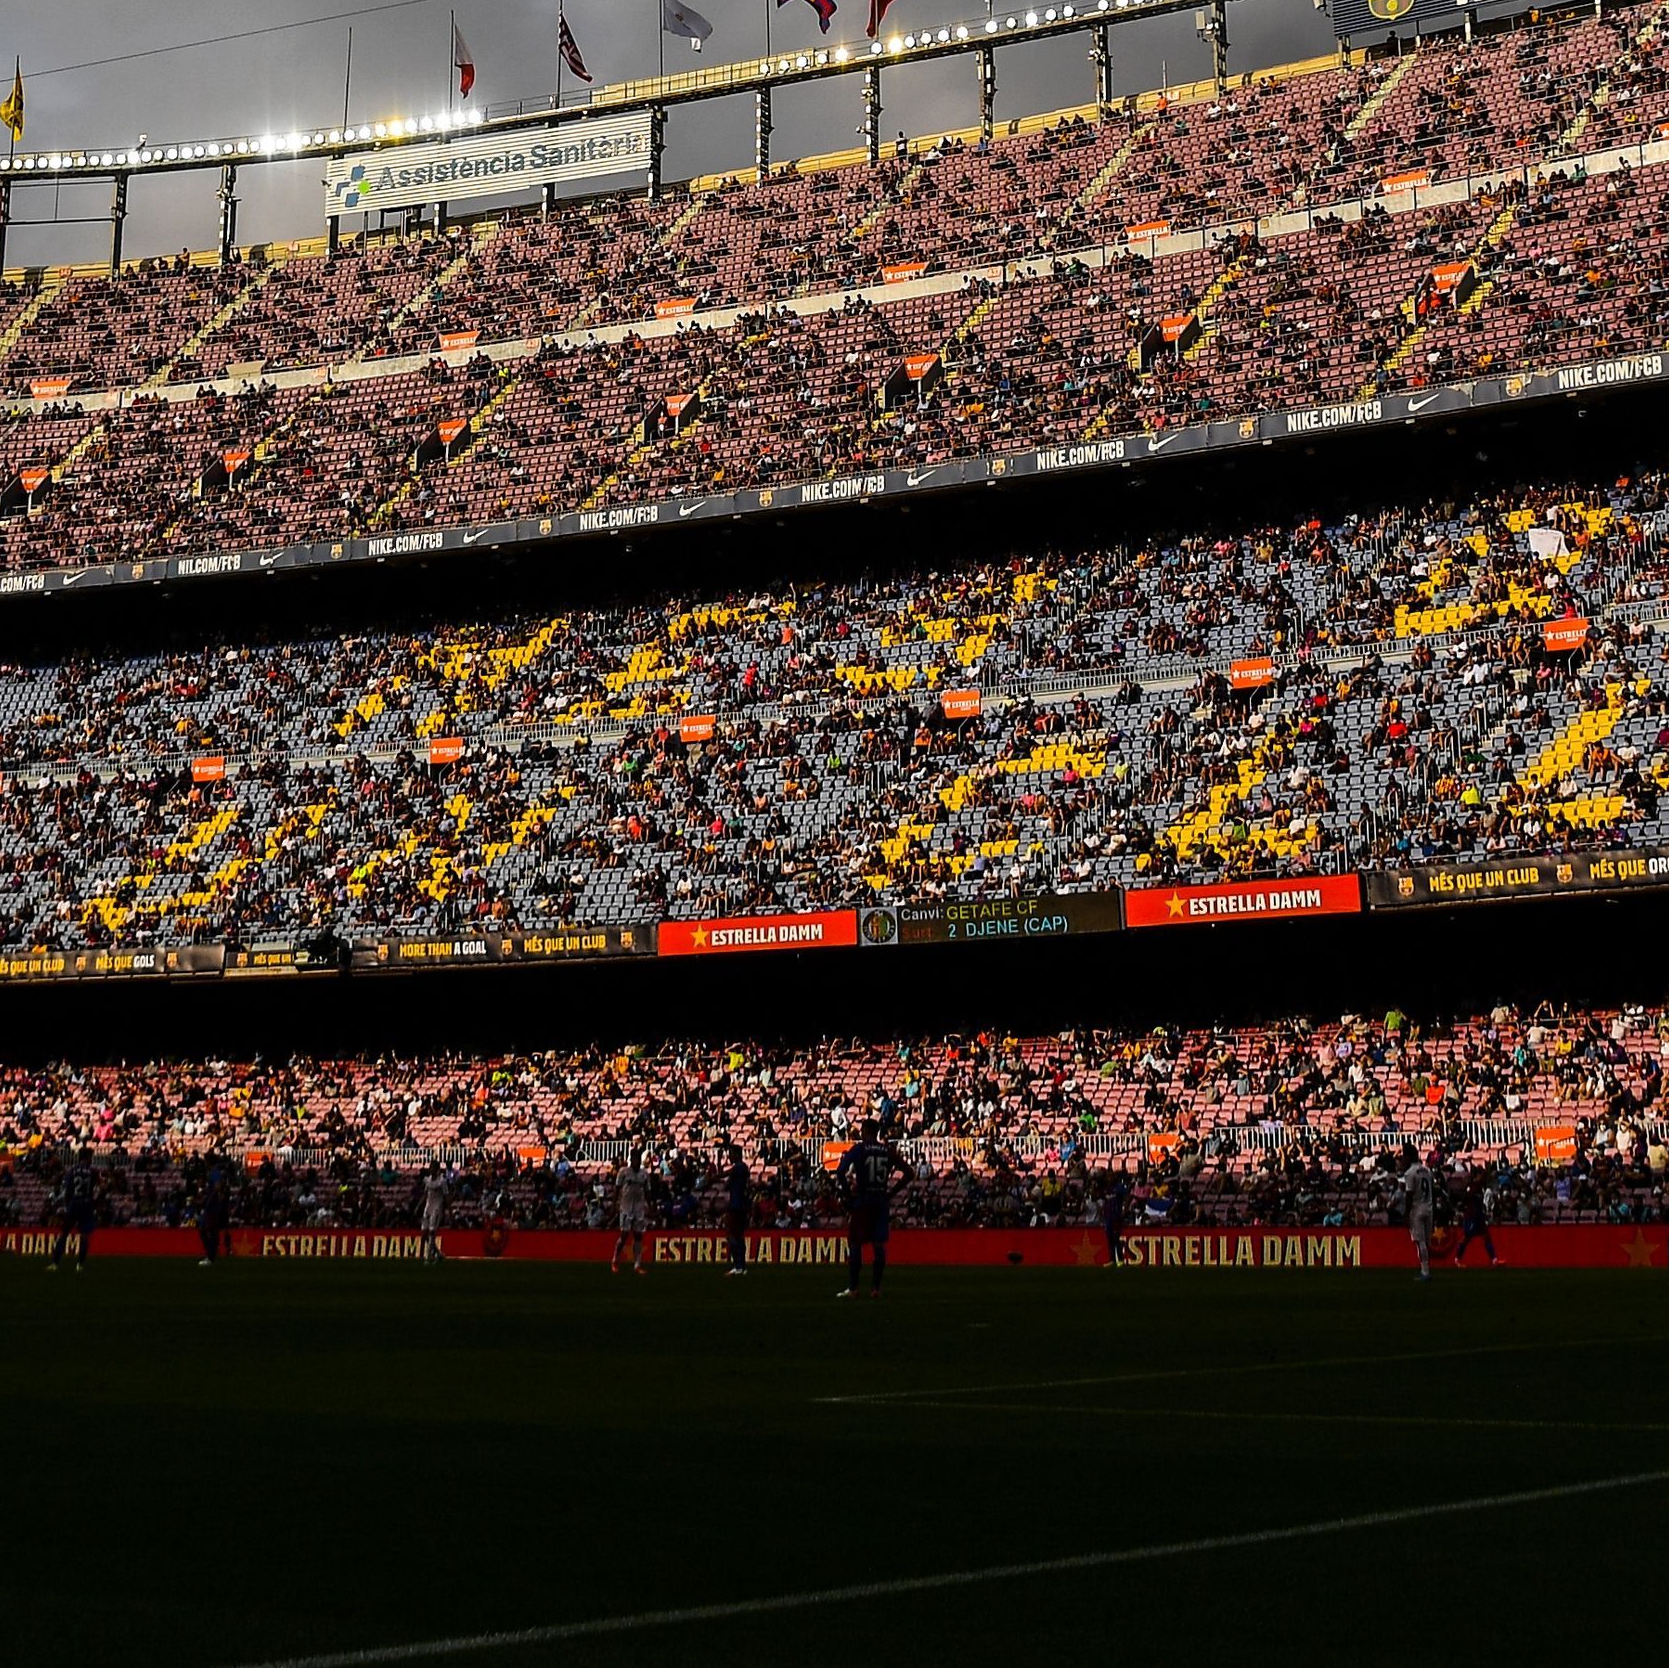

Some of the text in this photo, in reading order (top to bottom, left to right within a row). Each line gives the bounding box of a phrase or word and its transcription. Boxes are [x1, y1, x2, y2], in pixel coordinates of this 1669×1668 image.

[377, 149, 526, 190] Assistència
[1558, 355, 1662, 390] NIKE.COM/FCB
[1287, 401, 1382, 433] NIKE.COM/FCB
[580, 505, 659, 531] NIKE.COM/FCB
[368, 532, 443, 556] NIKE.COM/FCB
[1428, 865, 1540, 892] MÉS QUE UN CLUB
[1589, 858, 1616, 882] MÉS
[1617, 858, 1646, 879] QUE
[901, 899, 1038, 921] Canvi: GETAFE CF
[1189, 889, 1322, 916] ESTRELLA DAMM
[711, 923, 823, 947] ESTRELLA DAMM
[948, 923, 957, 938] 2
[965, 919, 1019, 938] DJENE
[1024, 915, 1069, 935] (CAP)
[399, 940, 487, 959] MORE THAN A GOAL
[524, 934, 607, 954] MÉS QUE UN CLUB
[10, 958, 29, 973] QUE
[29, 957, 41, 971] UN
[42, 956, 65, 971] CLUB
[95, 953, 155, 971] MÉS QUE GOLS
[865, 1156, 889, 1183] 15
[73, 1176, 91, 1197] 21
[263, 1234, 367, 1257] ESTRELLA
[655, 1235, 773, 1264] ESTRELA
[1262, 1235, 1362, 1268] DAMM
